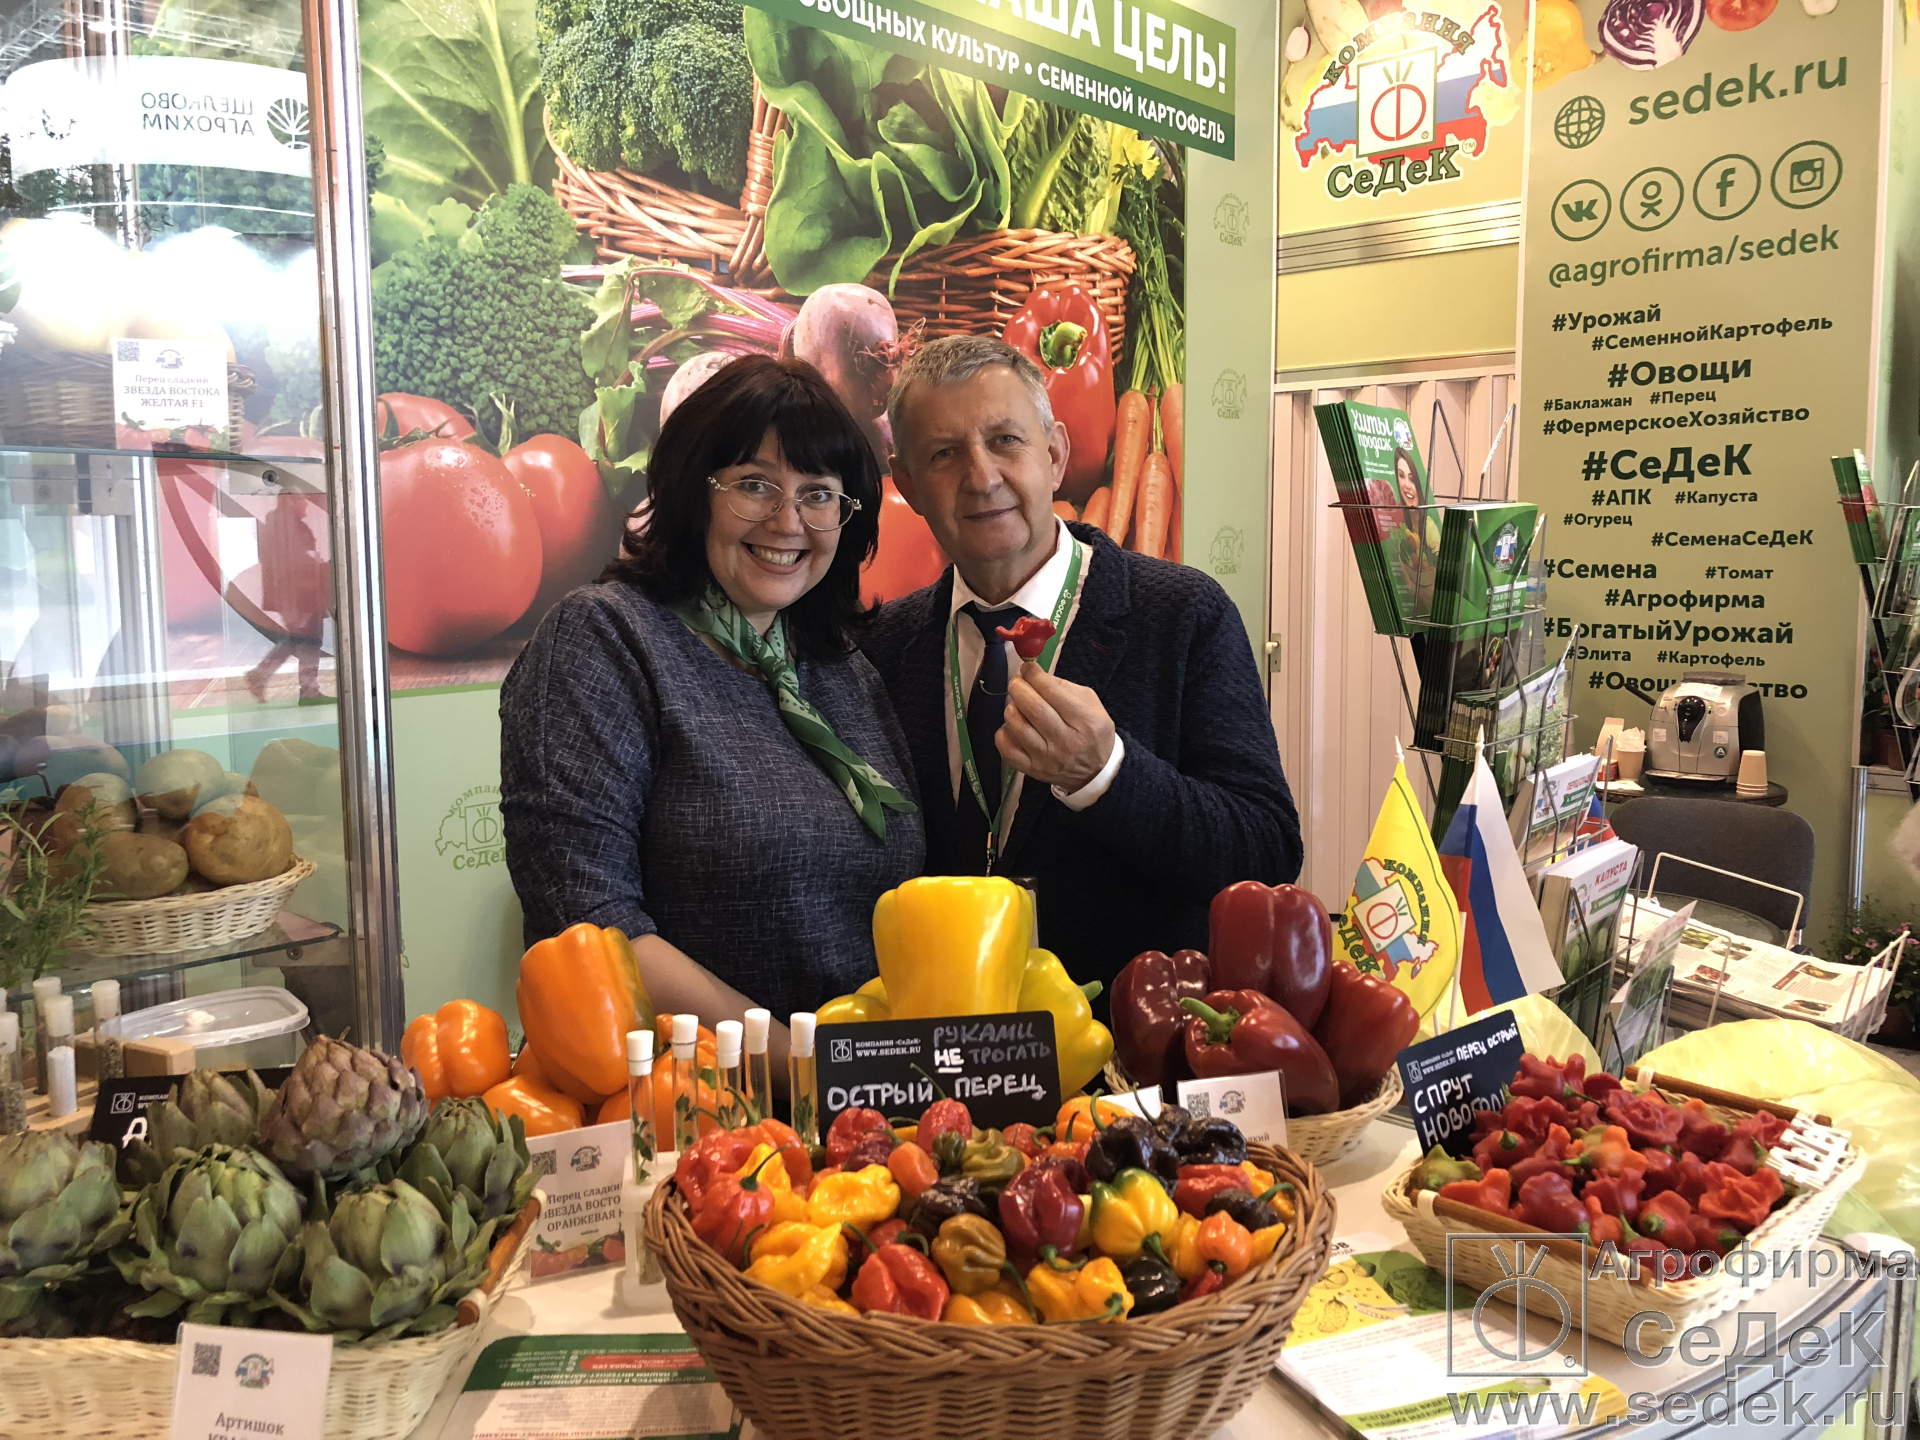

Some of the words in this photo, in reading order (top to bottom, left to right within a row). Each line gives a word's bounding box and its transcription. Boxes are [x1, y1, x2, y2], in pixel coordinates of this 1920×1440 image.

[1113, 0, 1226, 94] ЦЕЛЬ!
[931, 24, 1020, 75] КУЛЬТУР
[1037, 62, 1134, 114] СЕМЕННОЙ
[1137, 96, 1226, 145] КАРТОФЕЛЬ
[1628, 56, 1848, 125] sedek.ru
[1327, 145, 1461, 198] СеДеК
[1549, 224, 1840, 288] @agrofirma/sedek
[1552, 304, 1662, 333] #Урожай
[1591, 316, 1834, 351] #СеменнойКартофель
[1607, 359, 1752, 388] #Овощи
[124, 386, 167, 396] ЗВЕЗДА
[169, 387, 221, 396] ВОСТОКА
[1543, 395, 1633, 412] #Баклажан
[1649, 390, 1717, 405] #Перец
[141, 399, 189, 408] ЖЕЛТАЯ
[192, 400, 204, 408] F1
[1542, 407, 1810, 436] #ФермерскоеХозяйство
[1581, 443, 1753, 484] #СеДеК
[1591, 489, 1652, 506] #АПК
[1674, 490, 1759, 505] #Капуста
[1563, 512, 1633, 527] #Огурец
[1651, 529, 1814, 547] #СеменаСеДеК
[1545, 558, 1657, 579] #Семена
[1705, 566, 1774, 579] #Томат
[1605, 588, 1766, 612] #Агрофирма
[1544, 617, 1794, 646] #БогатыйУрожай
[1565, 645, 1632, 662] #Элита
[1656, 650, 1766, 668] #Картофель
[1595, 861, 1627, 886] КАПУСТА
[855, 1039, 894, 1048] КОМПАНИЯ
[933, 1022, 1036, 1047] РУКАМИ
[856, 1046, 922, 1057] WWW.SEDEK.RU
[934, 1048, 965, 1067] НЕ
[968, 1041, 1051, 1065] ТРОГАТЬ
[1456, 1041, 1488, 1061] ПЕРЕЦ
[827, 1076, 934, 1111] ОСТРЫЙ
[954, 1073, 1046, 1100] ПЕРЕЦ
[1414, 1073, 1473, 1114] СПРУТ
[548, 1191, 581, 1205] Перец
[585, 1195, 621, 1211] ВОСТО
[547, 1210, 616, 1233] ОРАНЖЕВАЯ
[215, 1412, 285, 1436] Артишок
